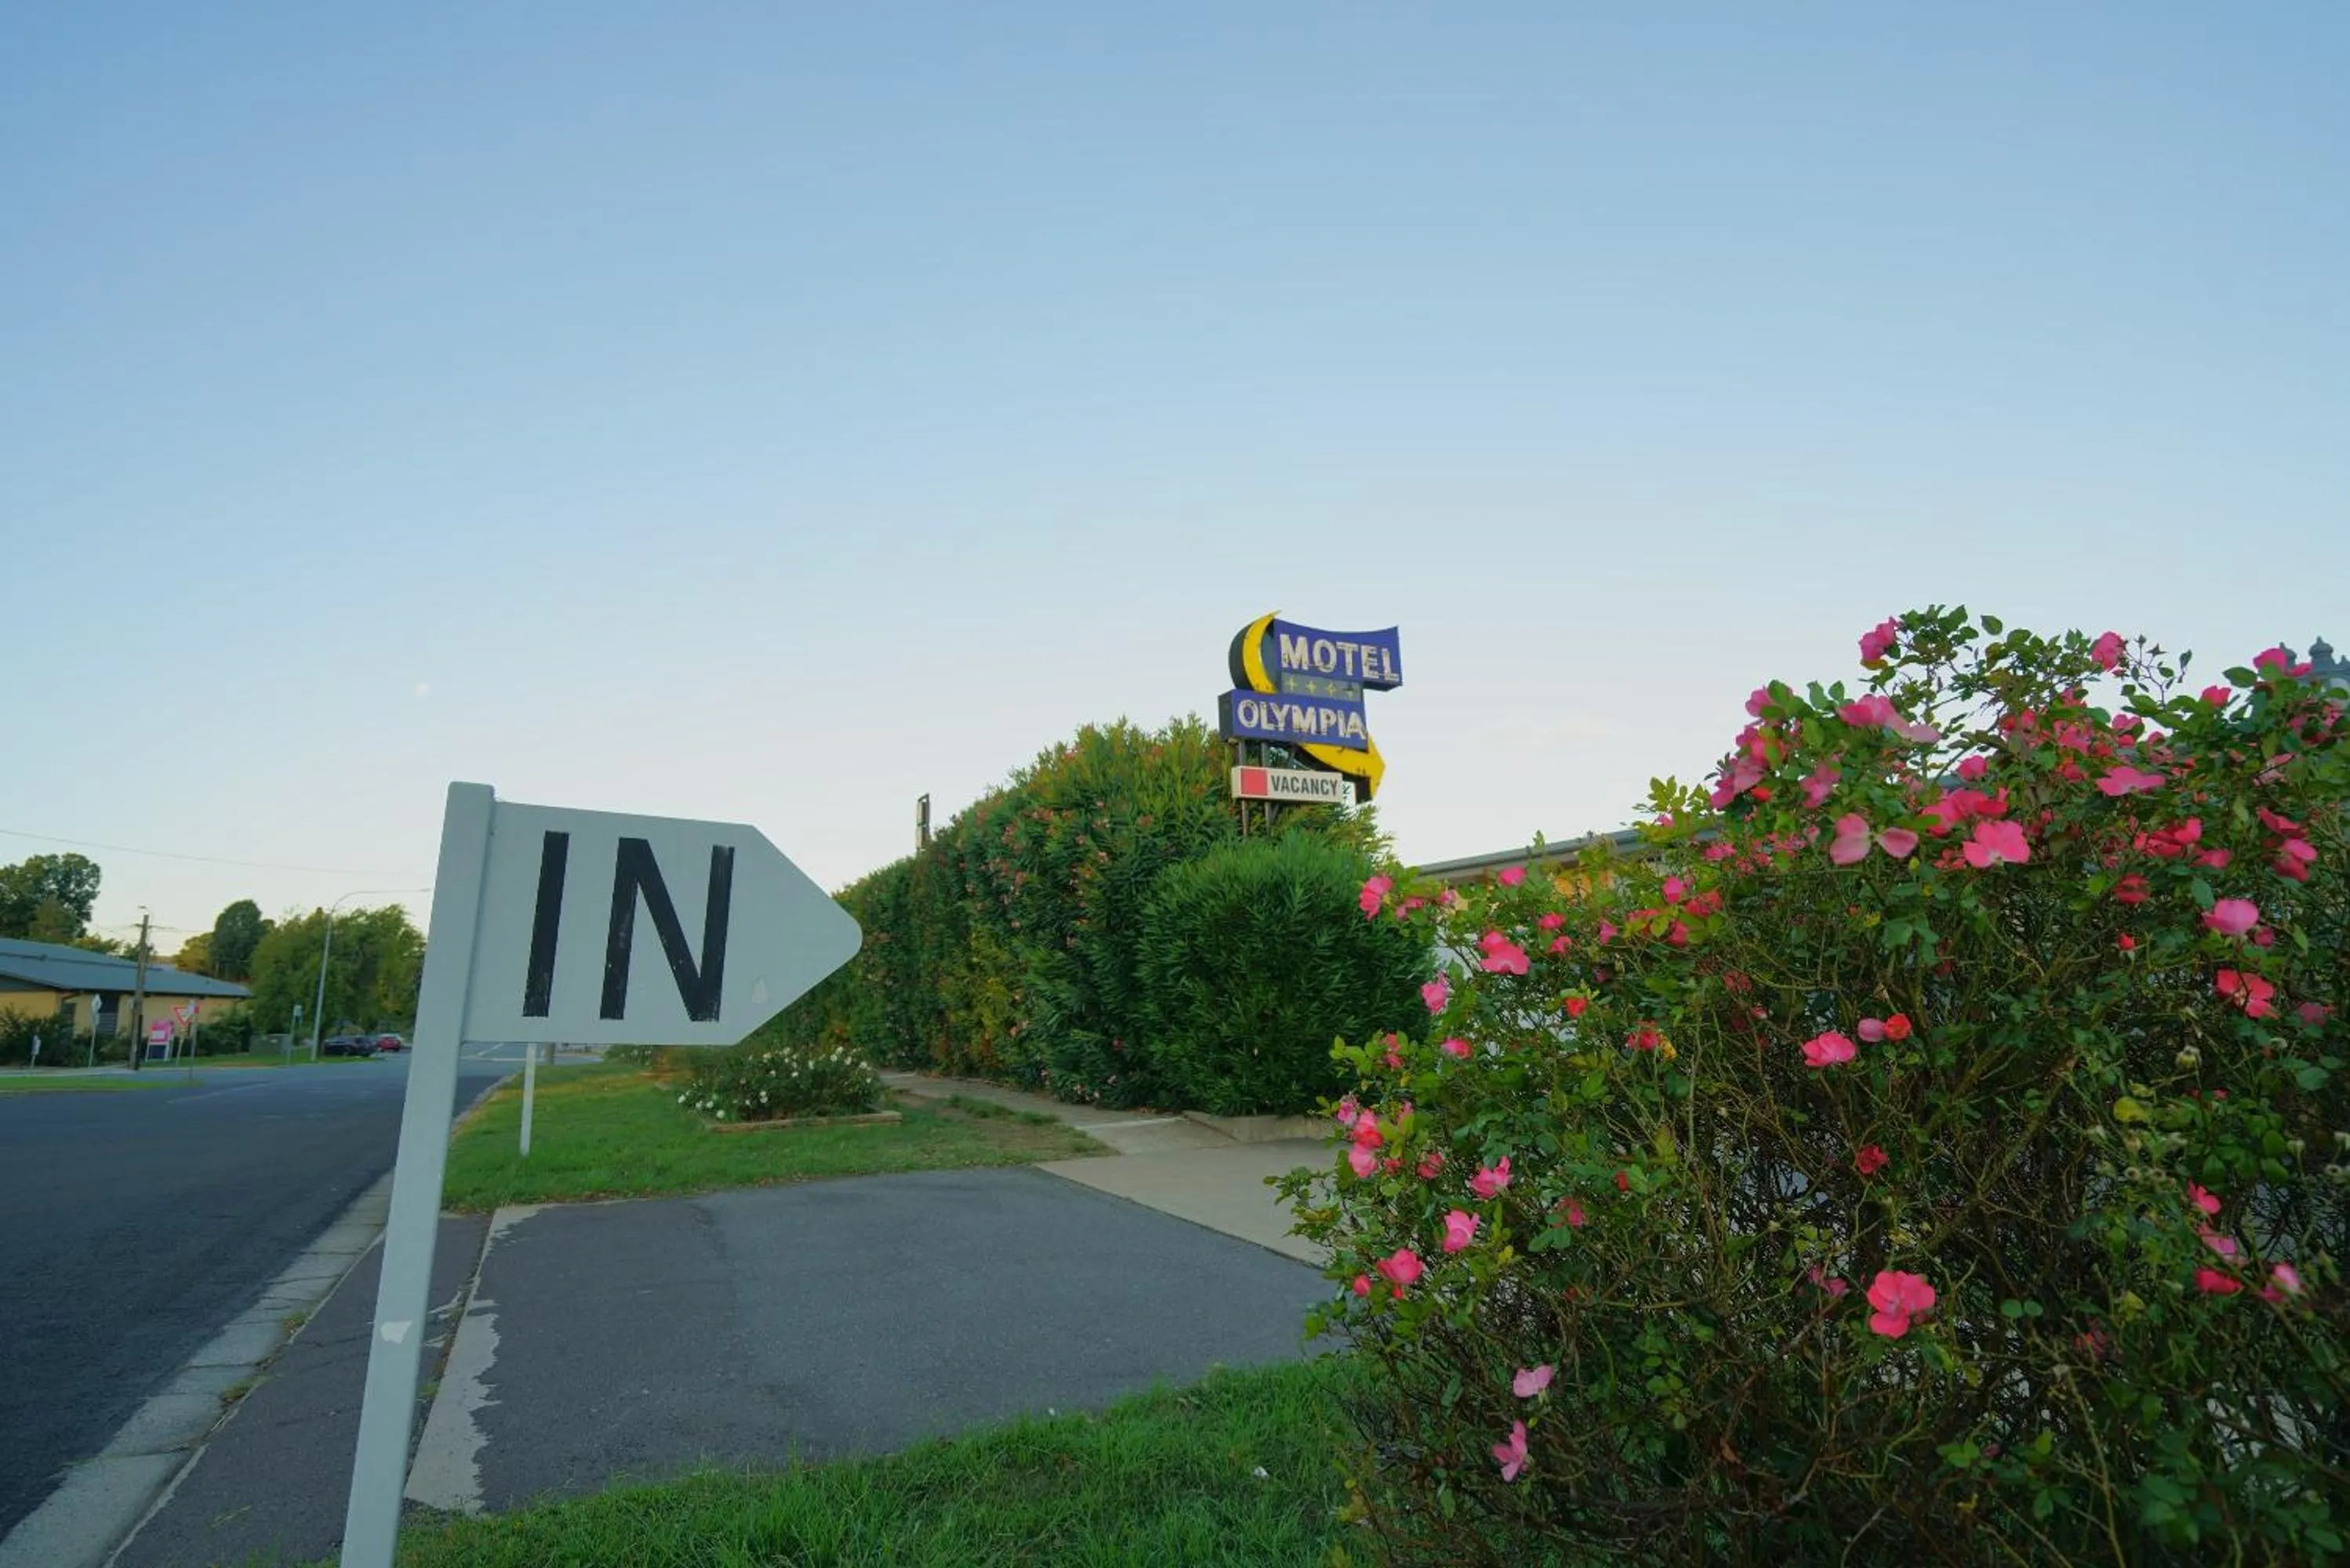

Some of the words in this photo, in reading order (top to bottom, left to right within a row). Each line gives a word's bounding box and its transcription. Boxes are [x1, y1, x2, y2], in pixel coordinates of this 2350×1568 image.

[1280, 633, 1399, 681] MOTEL
[1237, 699, 1366, 739] OLYMPIA
[1270, 775, 1338, 796] VACANCY
[522, 830, 735, 1022] IN
